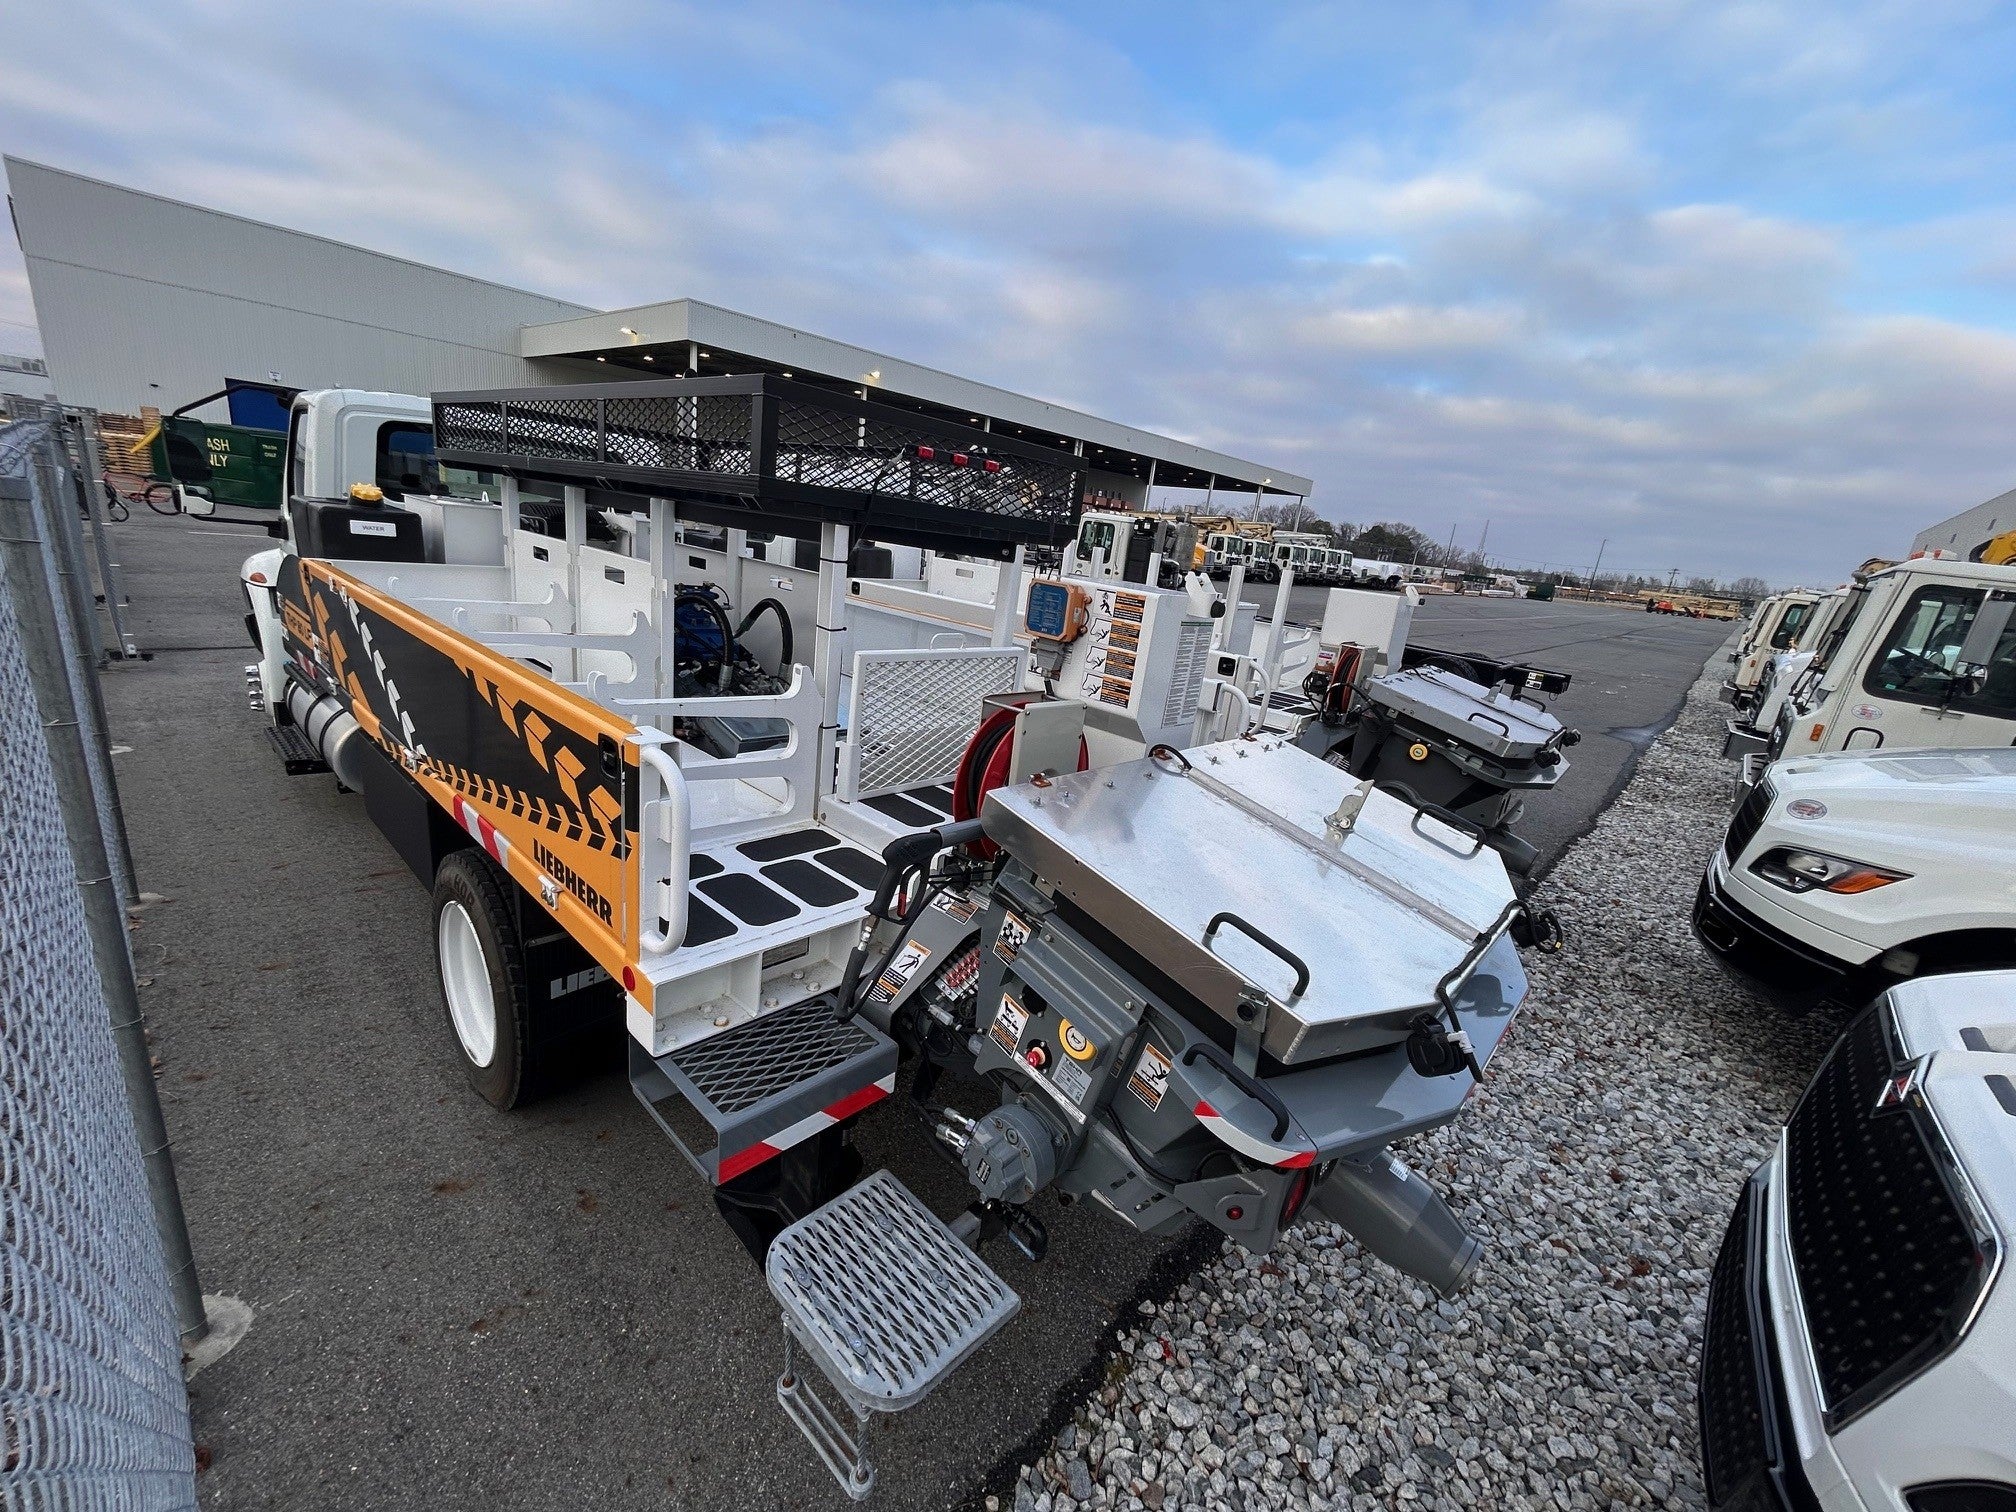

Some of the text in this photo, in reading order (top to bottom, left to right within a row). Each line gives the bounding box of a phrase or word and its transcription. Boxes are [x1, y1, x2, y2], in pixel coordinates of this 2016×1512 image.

[206, 437, 230, 452] ASH
[209, 453, 228, 467] NLY
[533, 837, 613, 928] LIEBHERR
[550, 965, 612, 1000] LIEB
